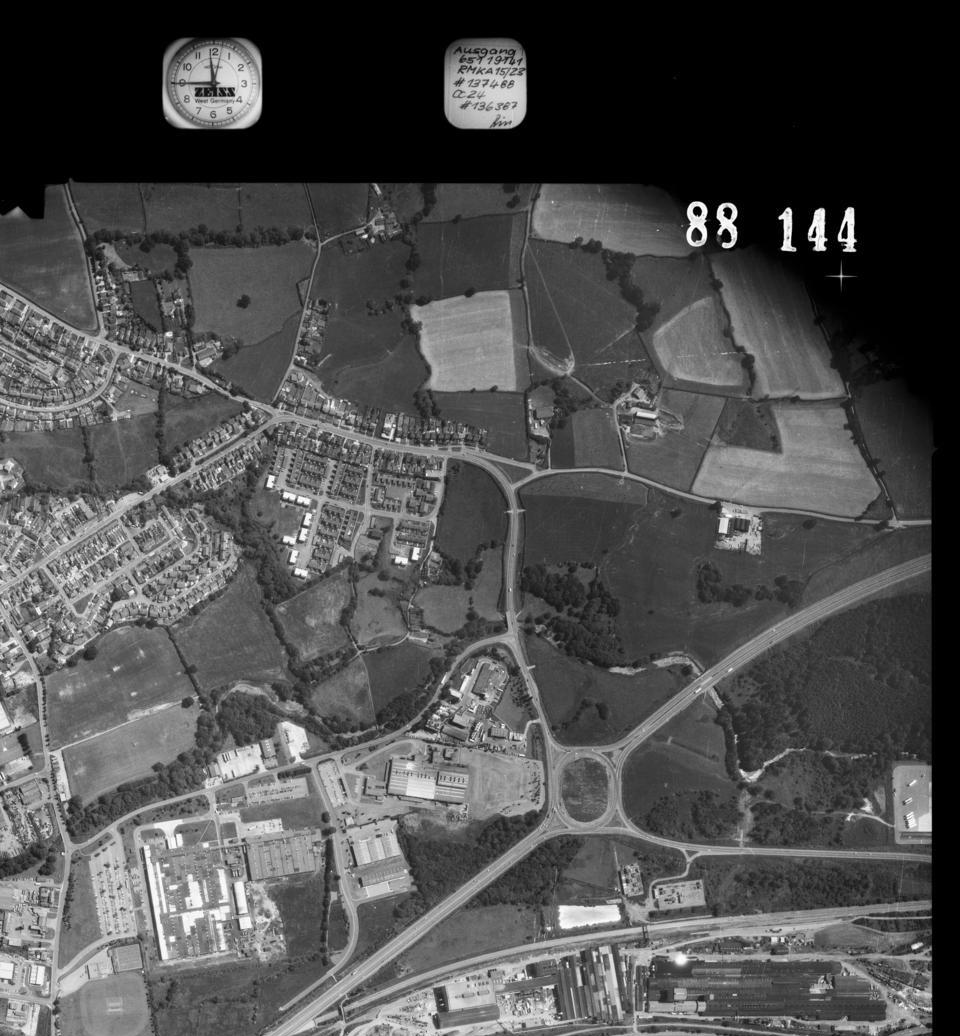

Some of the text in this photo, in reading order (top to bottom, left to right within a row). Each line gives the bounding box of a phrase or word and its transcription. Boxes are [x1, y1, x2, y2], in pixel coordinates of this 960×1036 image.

[195, 51, 201, 60] 11
[453, 46, 516, 60] Ausgang
[183, 62, 192, 71] 10
[238, 64, 245, 72] 2
[179, 79, 186, 87] 9
[241, 80, 248, 88] 3
[194, 86, 235, 97] ZEISS
[184, 95, 191, 103] 8
[236, 96, 243, 104] 4
[196, 107, 202, 115] 7
[210, 111, 217, 119] 6
[227, 107, 233, 115] 5
